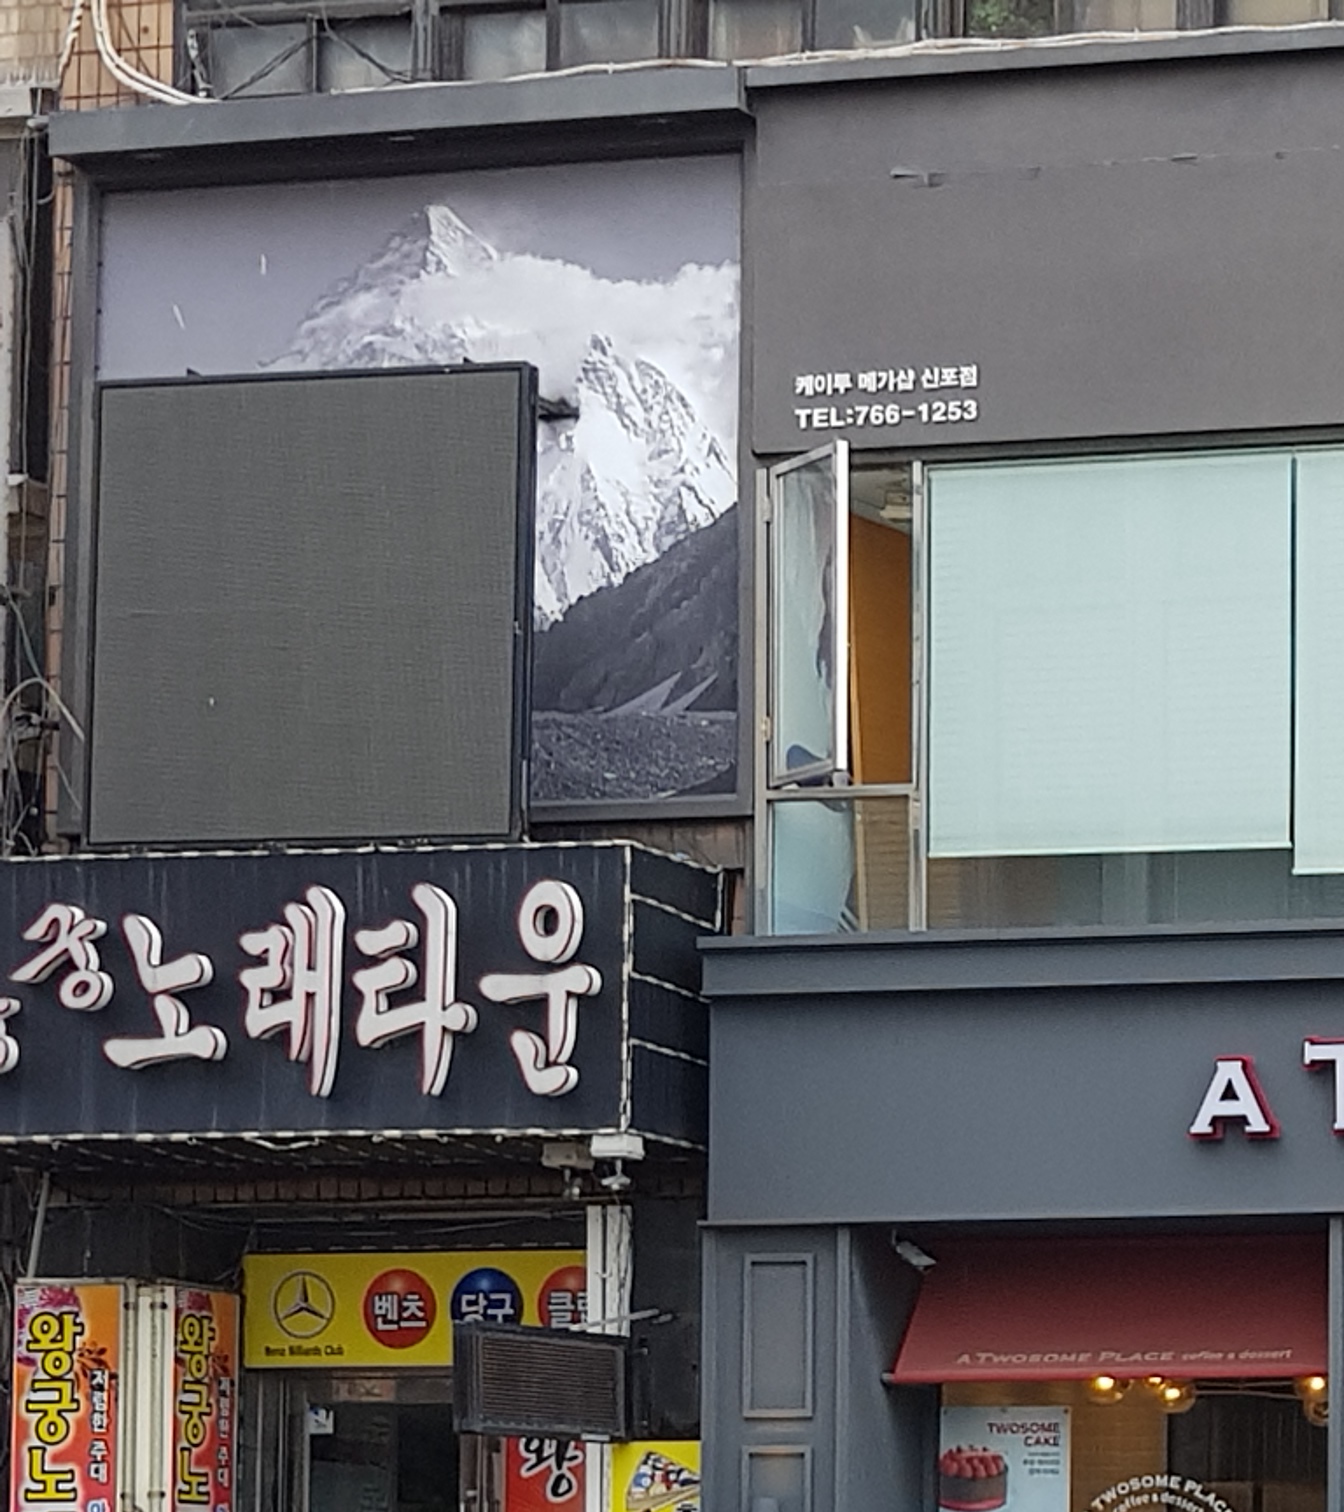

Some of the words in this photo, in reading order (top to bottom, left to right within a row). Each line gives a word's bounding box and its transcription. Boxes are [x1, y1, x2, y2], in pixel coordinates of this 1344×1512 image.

[795, 374, 851, 396] 케이투
[921, 364, 978, 389] 신포점
[795, 400, 978, 429] TEL:766-1253
[1189, 1053, 1277, 1139] A
[374, 1293, 427, 1331] 벤츠
[987, 1422, 1061, 1434] TWOSOME
[1024, 1435, 1060, 1447] CAKE
[1091, 1474, 1182, 1511] TWOSOME
